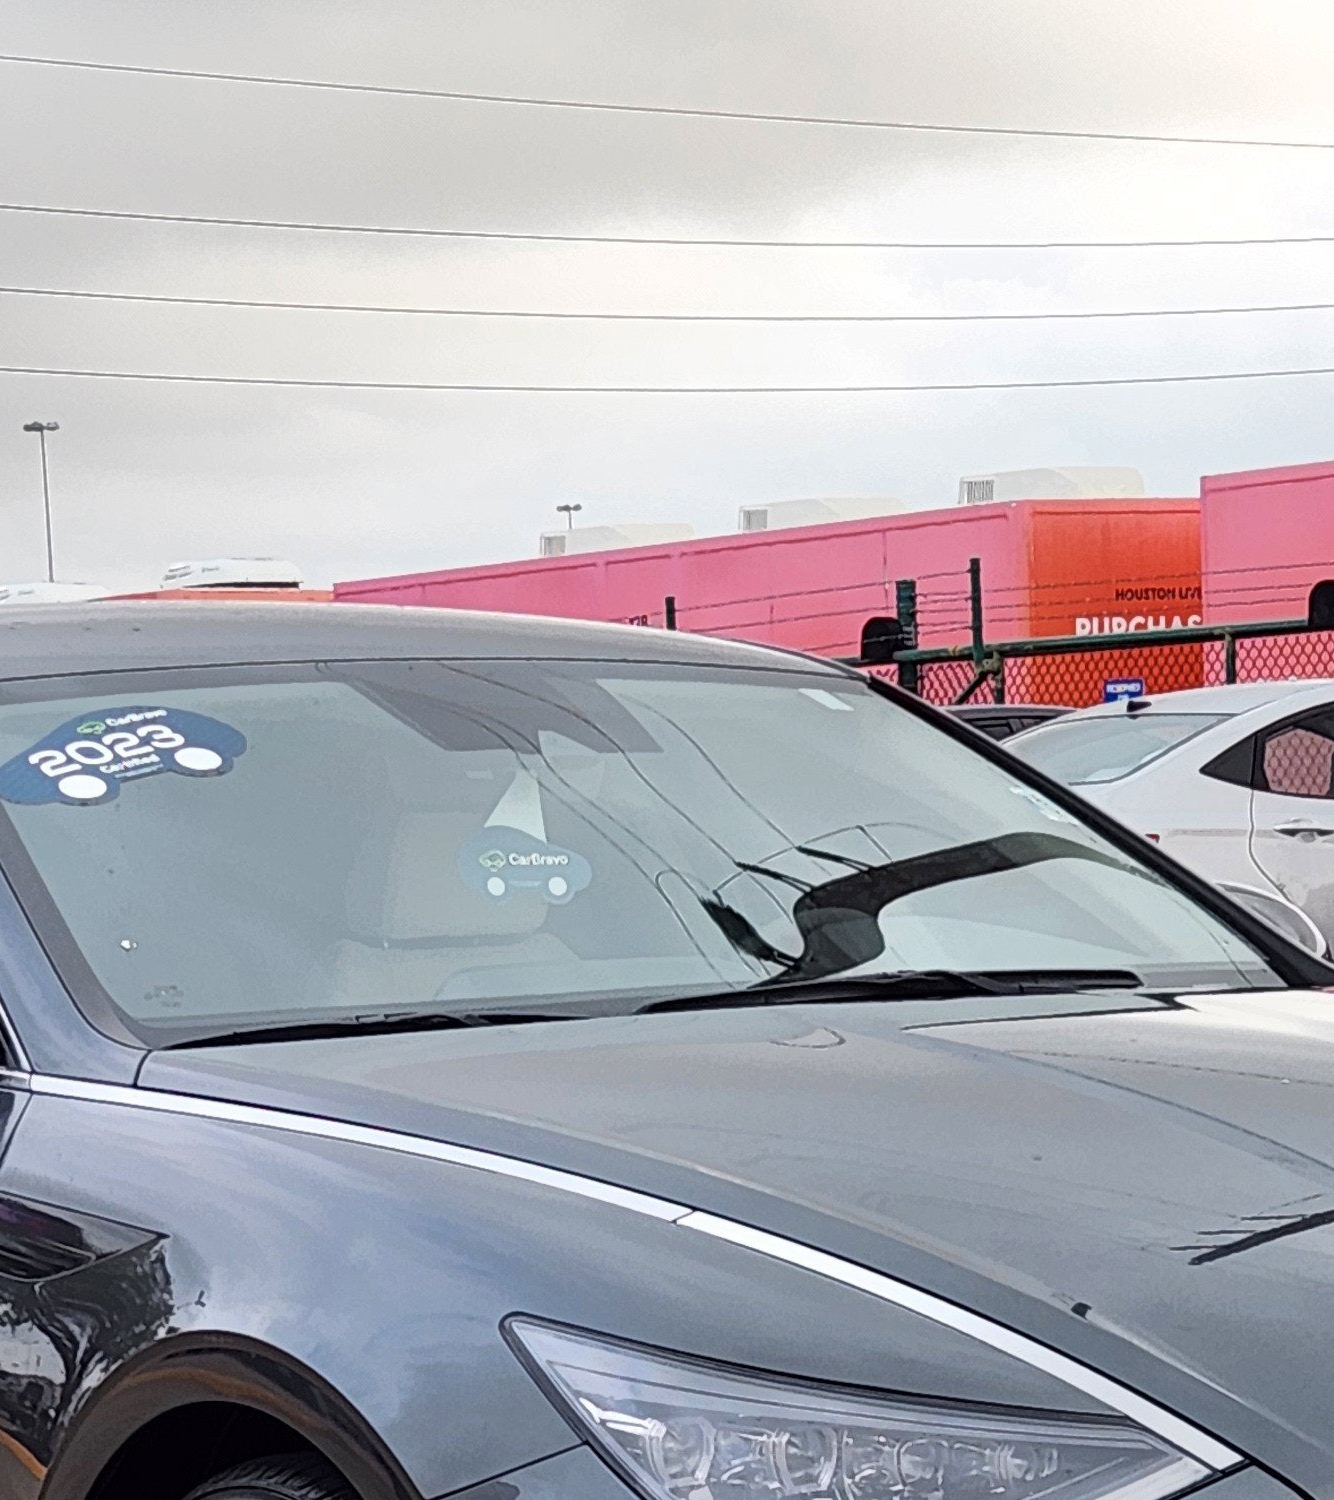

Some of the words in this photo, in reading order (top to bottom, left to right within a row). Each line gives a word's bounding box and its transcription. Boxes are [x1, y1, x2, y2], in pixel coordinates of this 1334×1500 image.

[1115, 587, 1176, 600] HOUSTON
[28, 724, 185, 778] 2023
[508, 853, 569, 866] CarBravo
